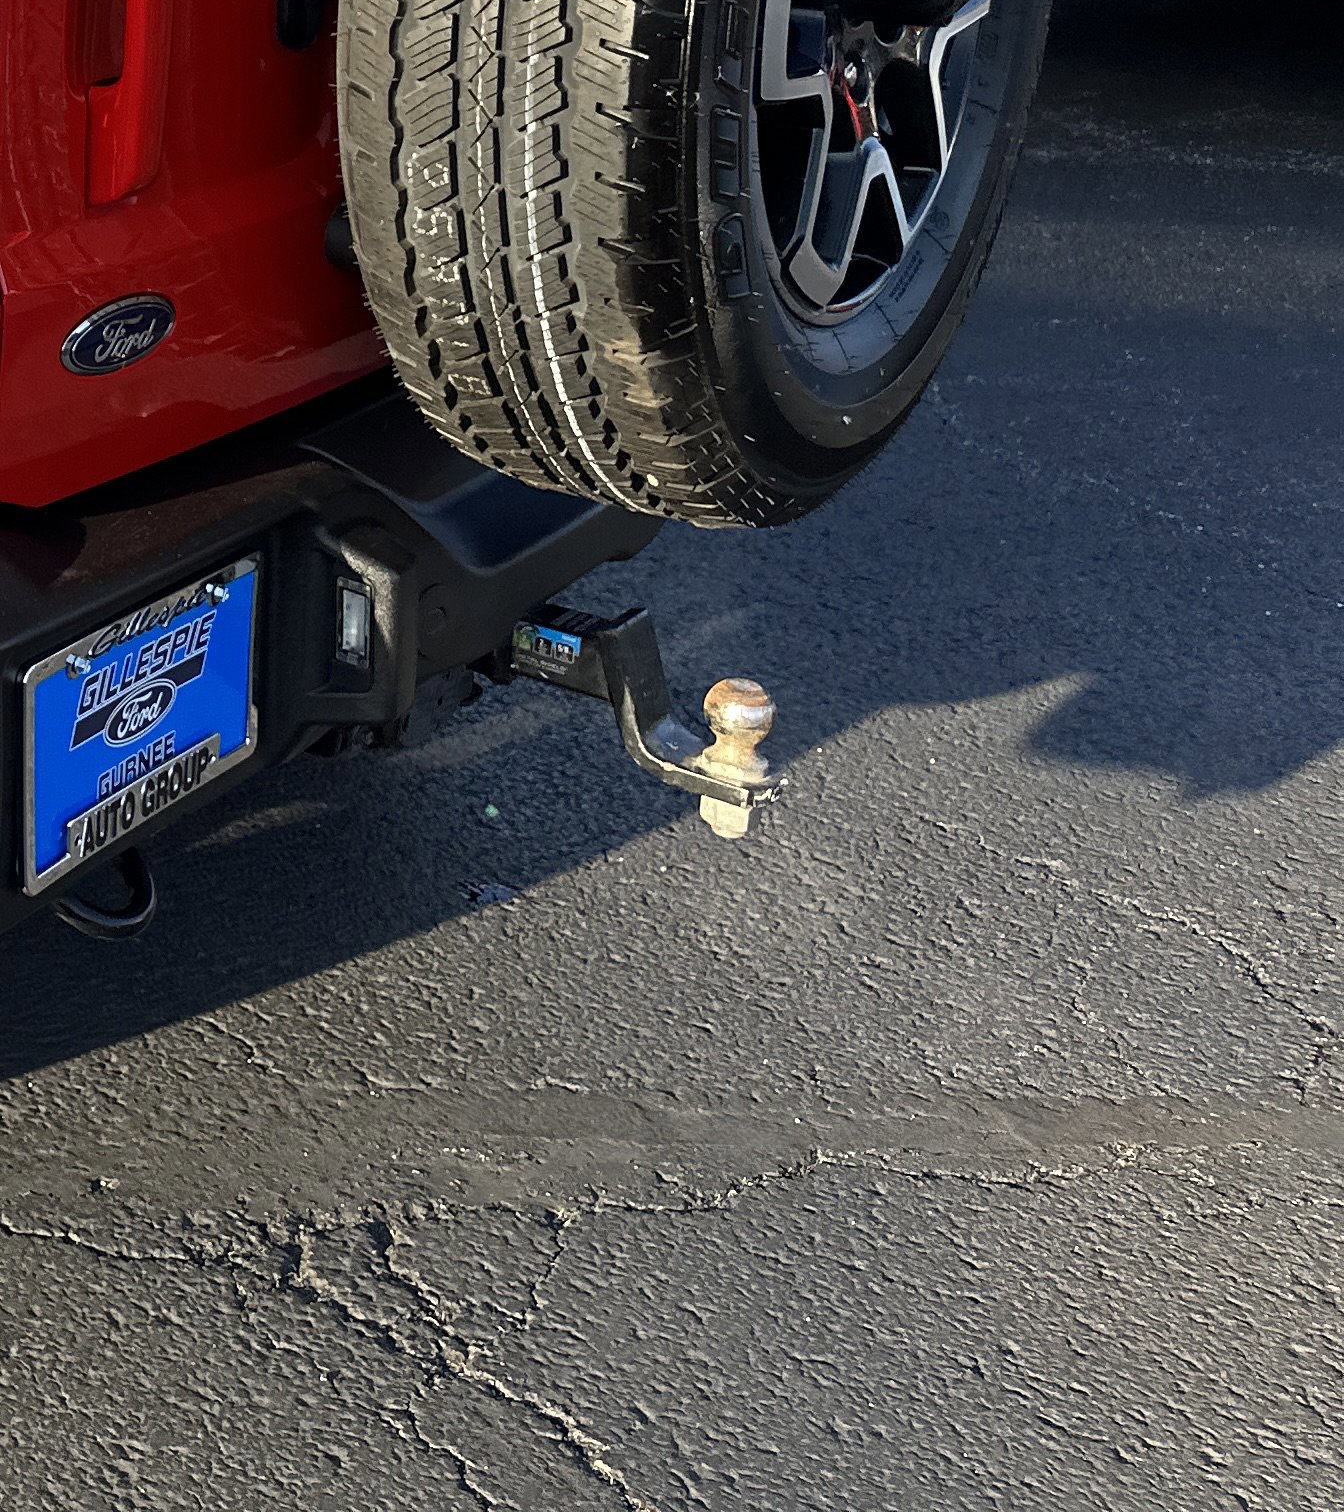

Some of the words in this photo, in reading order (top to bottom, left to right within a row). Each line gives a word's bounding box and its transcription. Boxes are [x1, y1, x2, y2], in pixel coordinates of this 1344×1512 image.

[76, 609, 218, 719] GILLESPIE
[117, 690, 164, 739] Ford
[79, 789, 137, 859] AUTO
[140, 745, 209, 818] GROUP
[96, 729, 177, 803] GURNEE
